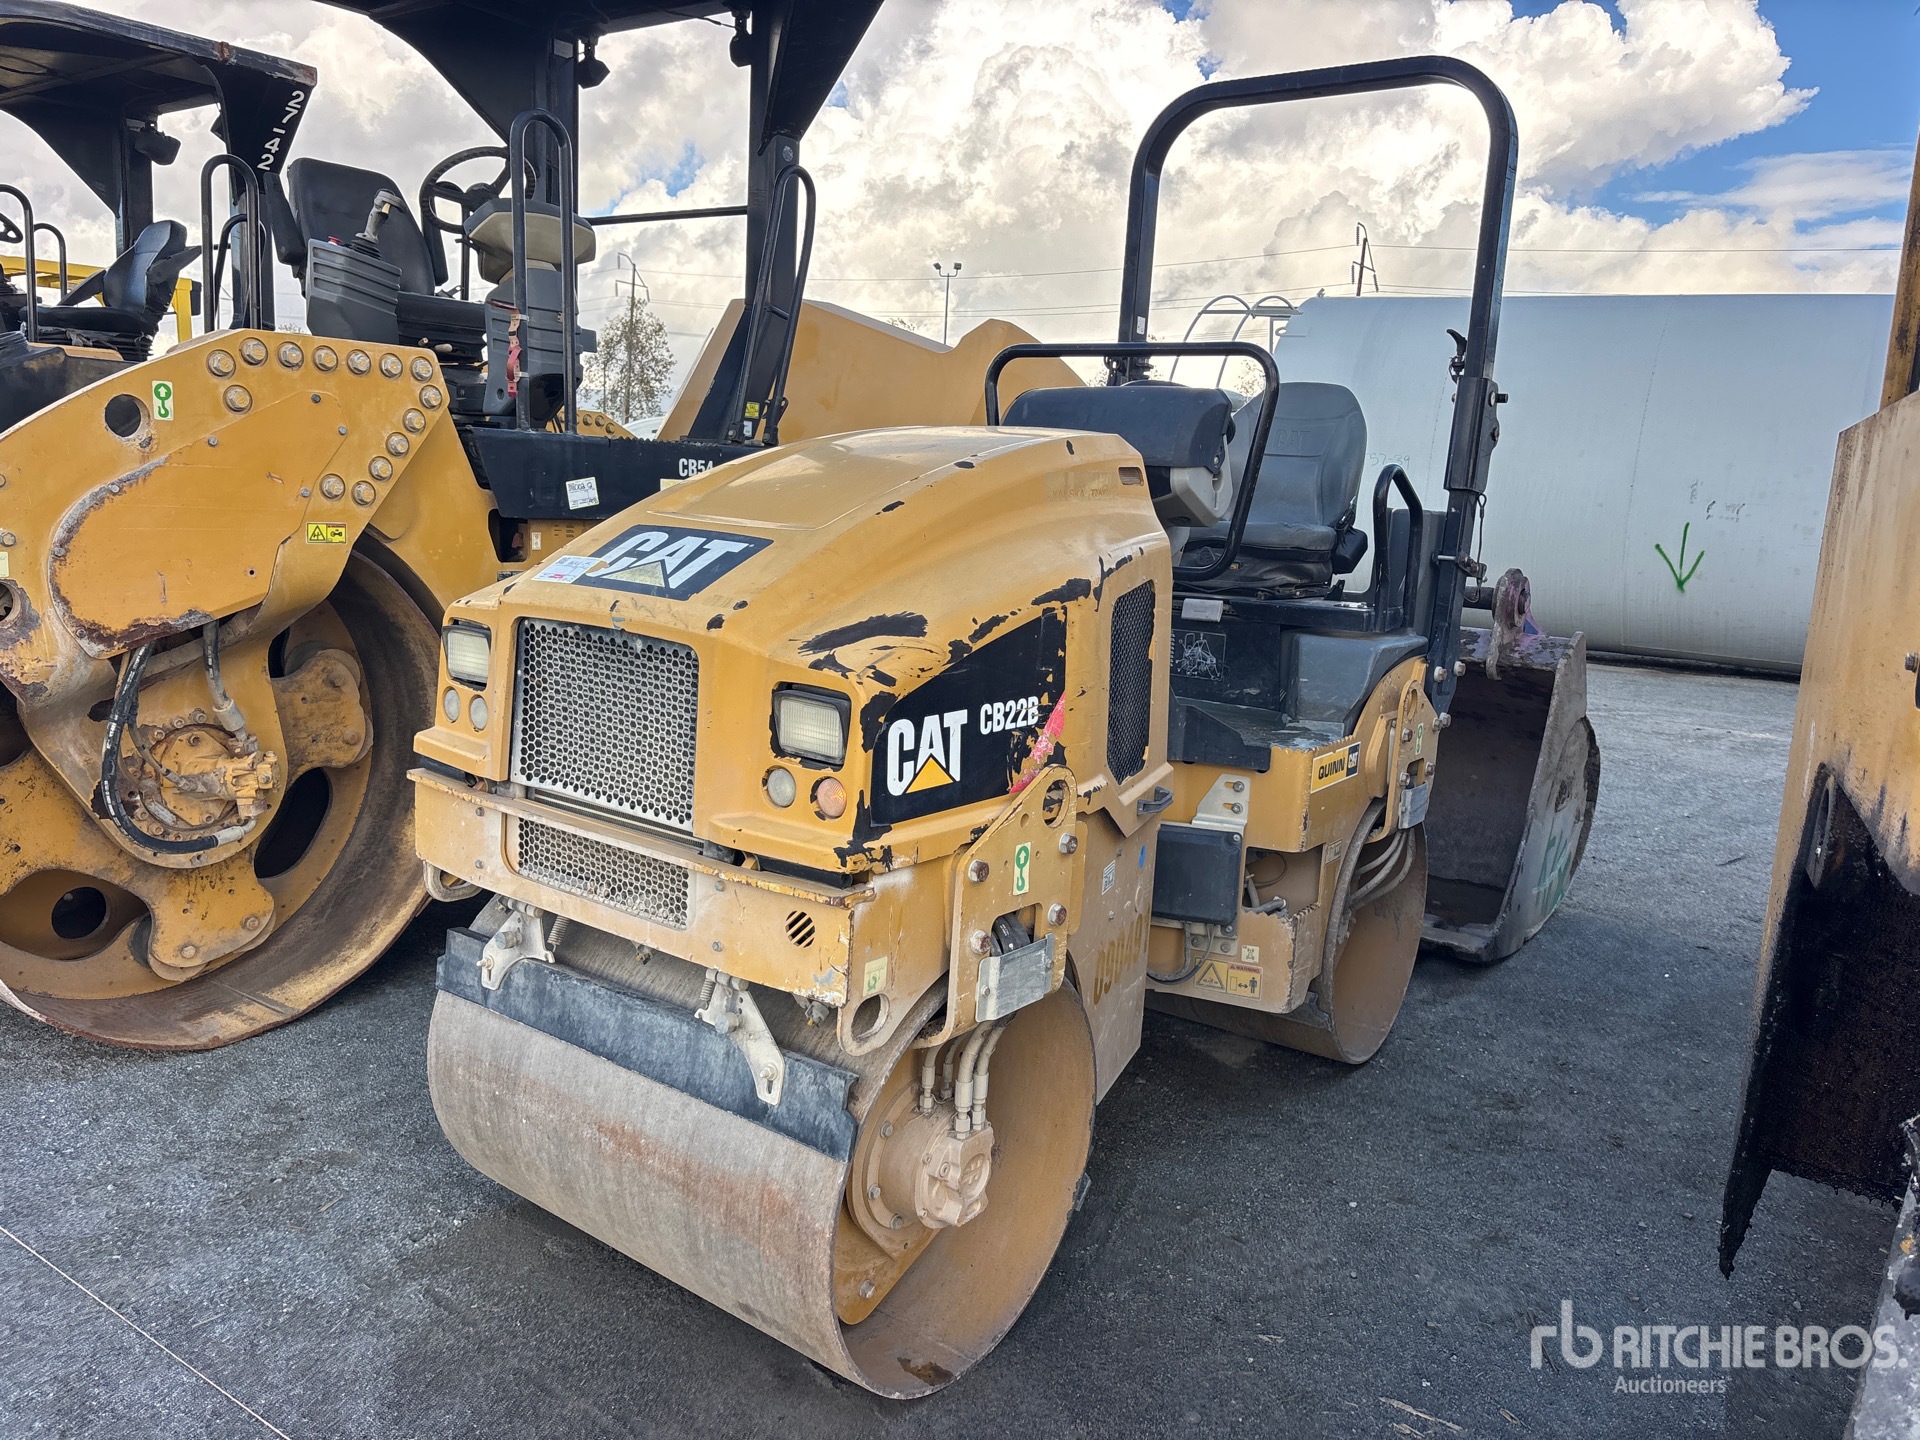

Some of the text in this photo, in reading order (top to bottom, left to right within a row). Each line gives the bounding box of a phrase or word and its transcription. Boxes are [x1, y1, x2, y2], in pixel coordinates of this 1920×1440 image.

[257, 90, 305, 171] 27-42
[586, 531, 750, 589] CAT
[980, 696, 1039, 735] CB22B
[887, 709, 968, 796] CAT
[1318, 757, 1346, 780] QUINN
[1235, 965, 1260, 974] WARNING
